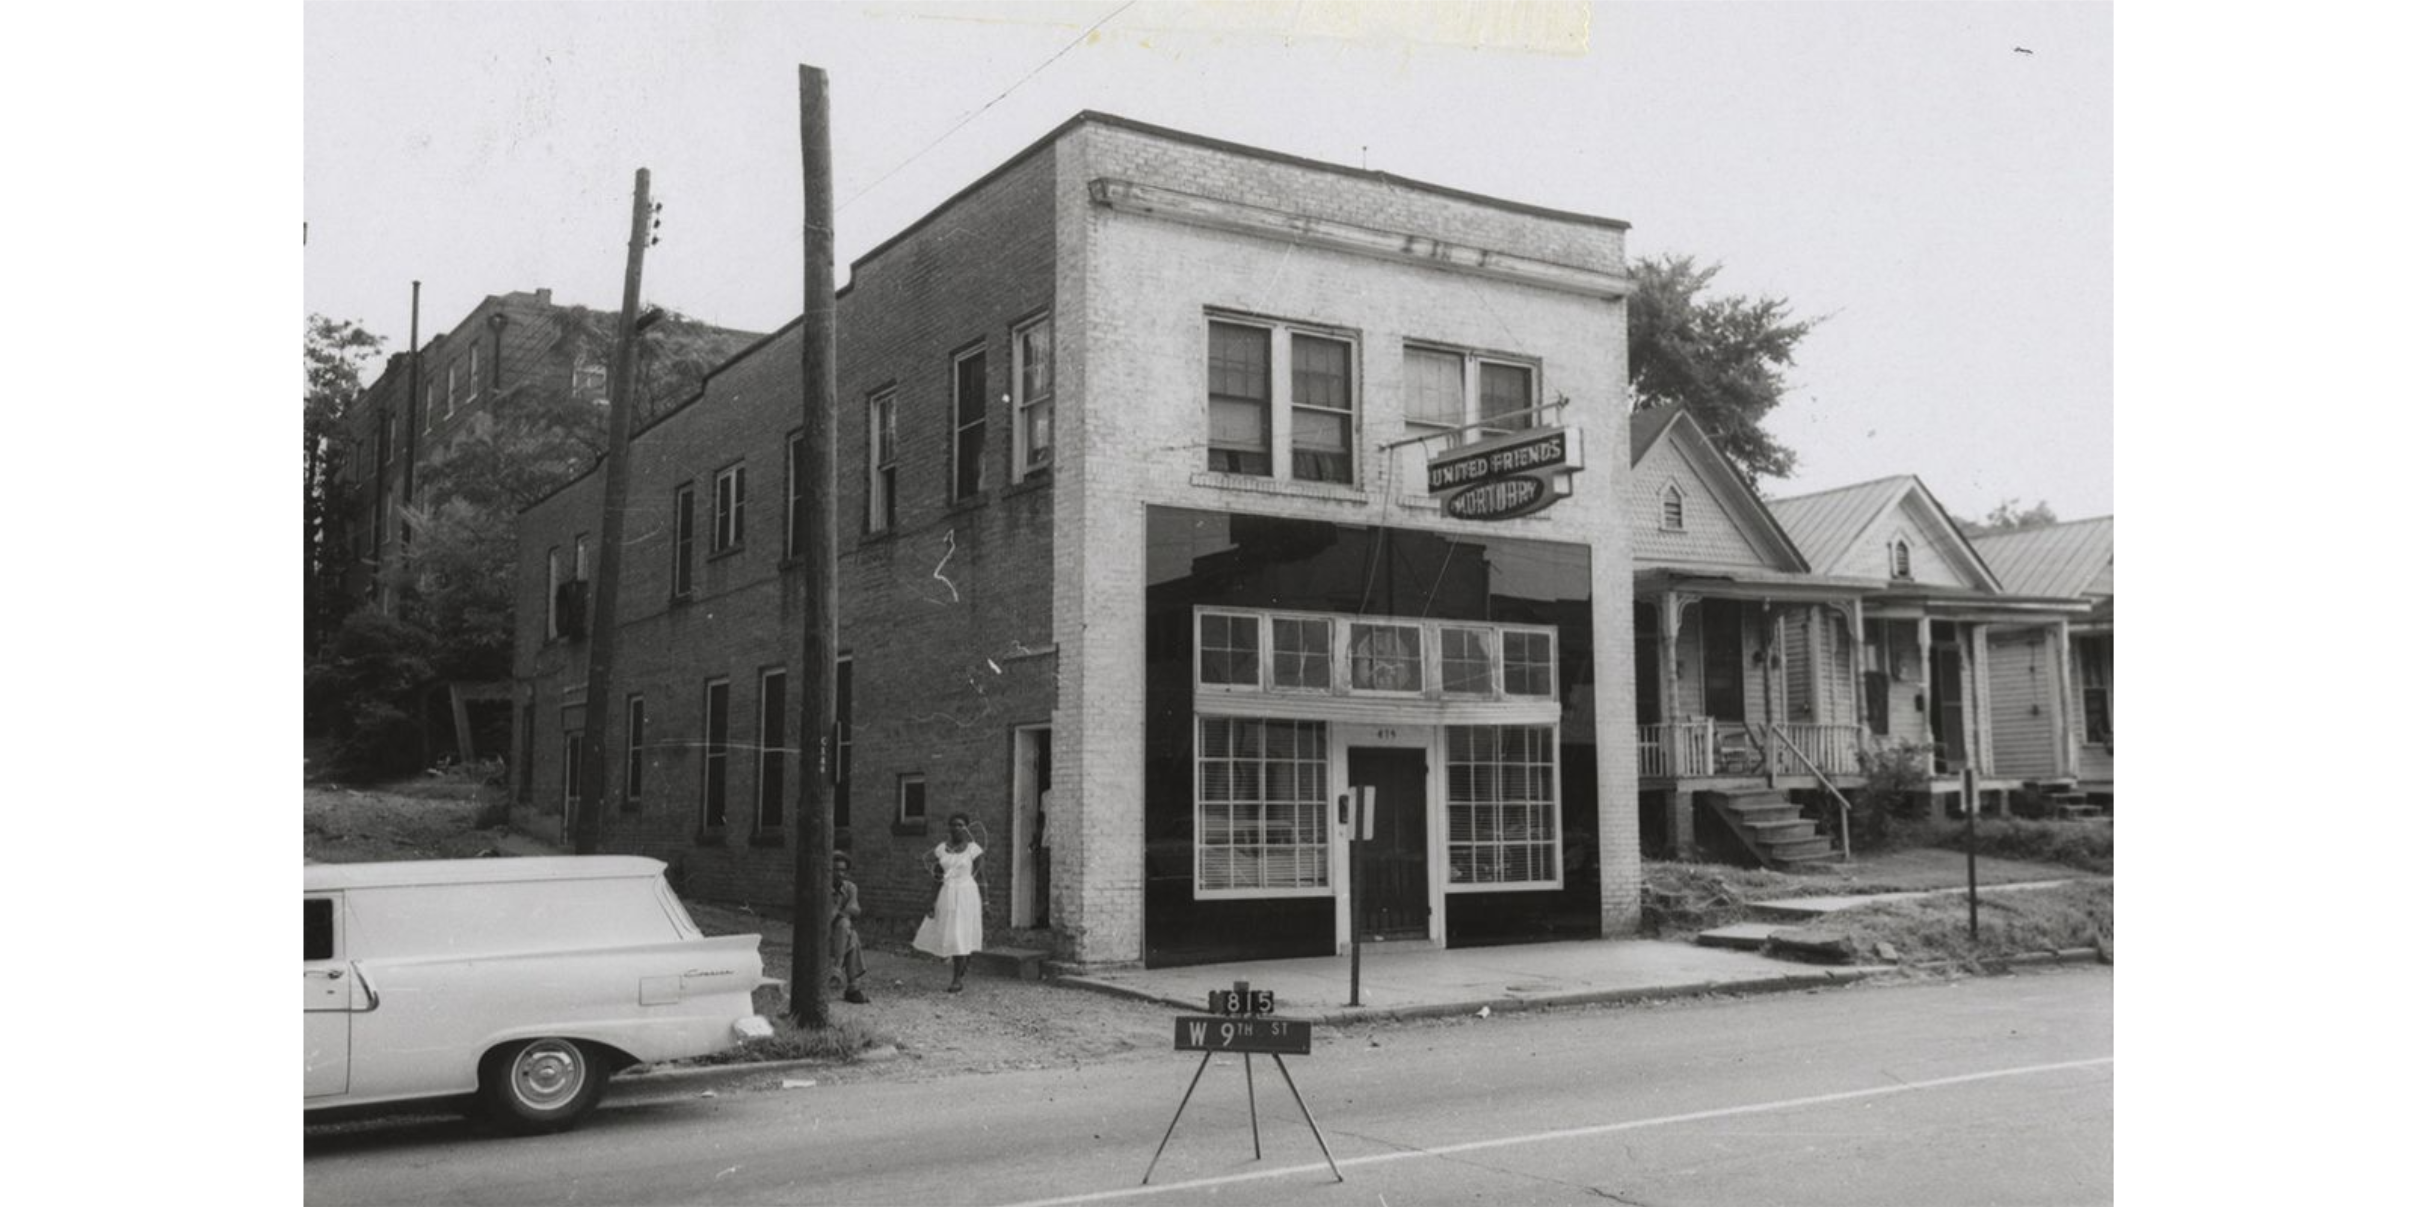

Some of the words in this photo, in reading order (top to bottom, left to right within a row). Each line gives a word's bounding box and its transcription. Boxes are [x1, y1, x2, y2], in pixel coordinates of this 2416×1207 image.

[1432, 458, 1488, 487] UNITED
[1490, 438, 1562, 474] FRIENDS
[1451, 480, 1537, 515] MORTUARY
[1227, 992, 1272, 1012] 815
[1189, 1022, 1207, 1047] W
[1220, 1022, 1253, 1047] 9TH
[1271, 1022, 1288, 1036] ST
